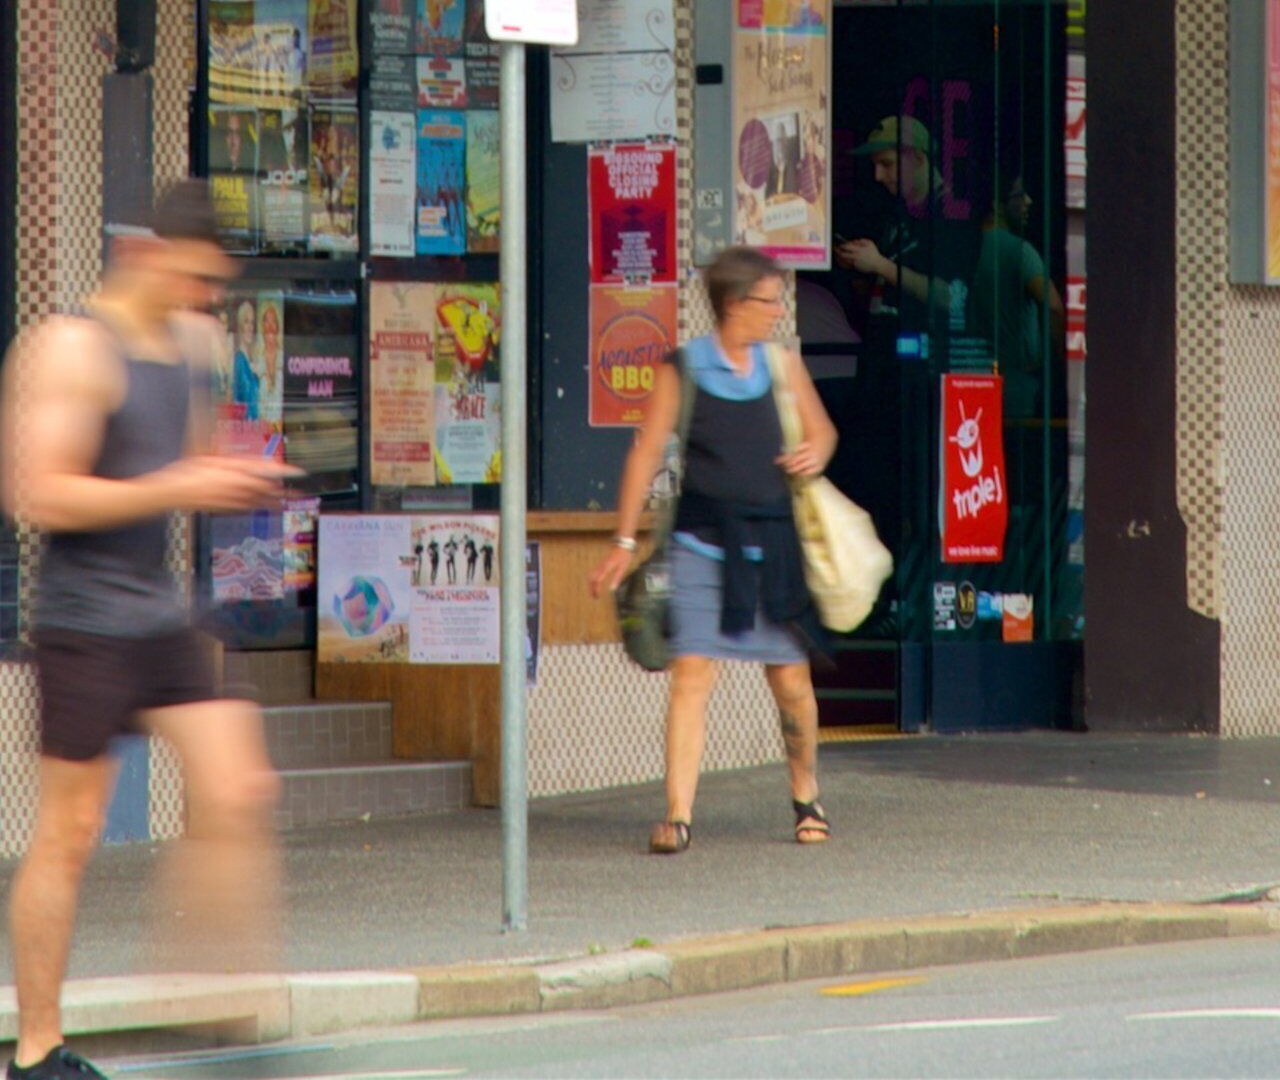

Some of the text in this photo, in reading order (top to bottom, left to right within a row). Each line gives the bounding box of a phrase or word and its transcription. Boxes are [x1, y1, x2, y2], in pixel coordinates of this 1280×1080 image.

[608, 175, 659, 189] CLOSING
[614, 187, 653, 200] PARTY
[610, 364, 655, 390] BBQ
[307, 380, 334, 397] MAN
